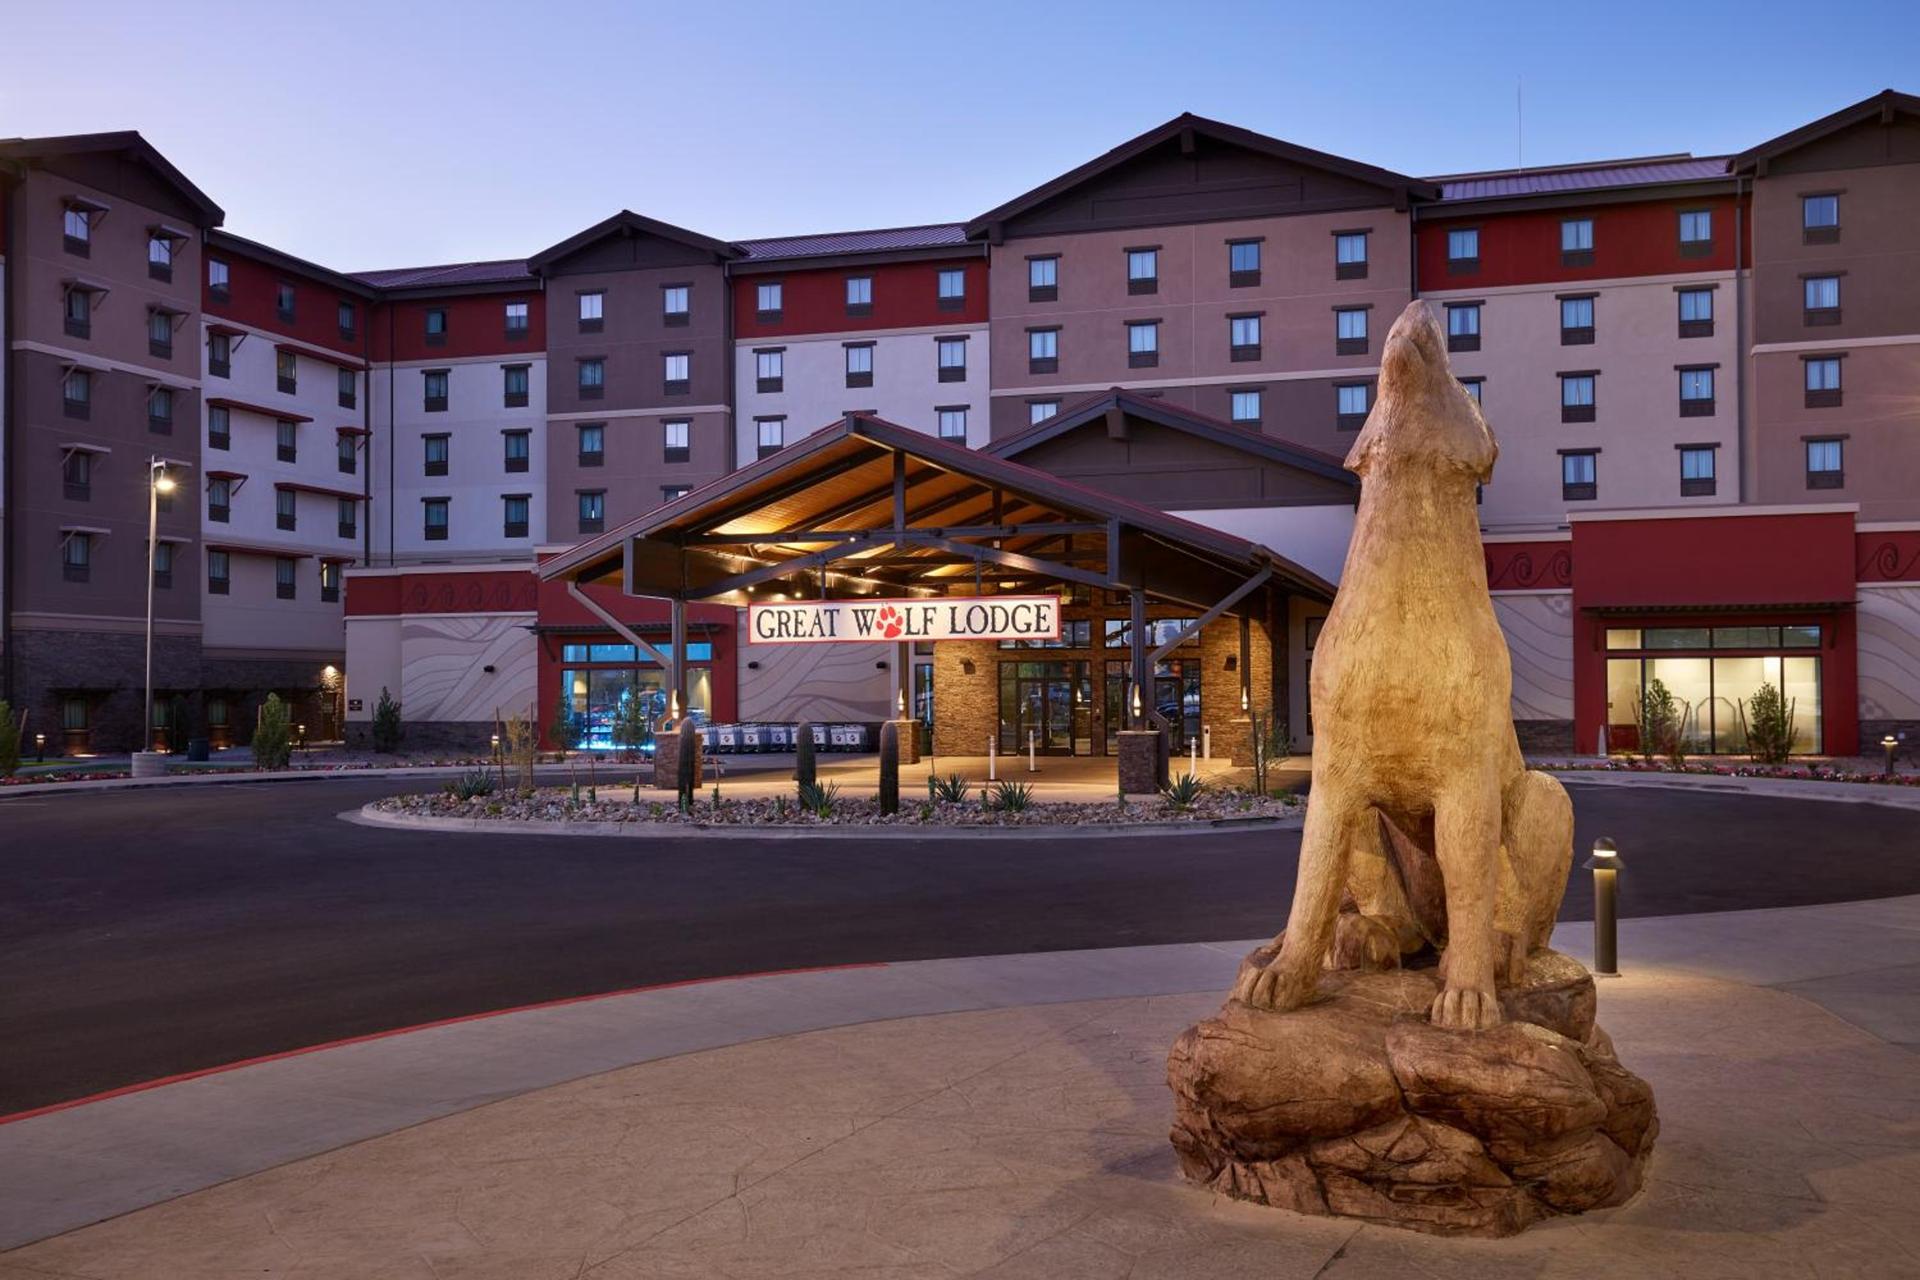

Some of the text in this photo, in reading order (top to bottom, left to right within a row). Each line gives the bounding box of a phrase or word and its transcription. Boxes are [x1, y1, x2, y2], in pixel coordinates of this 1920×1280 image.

[756, 604, 1051, 639] GREAT WLF LODGE
